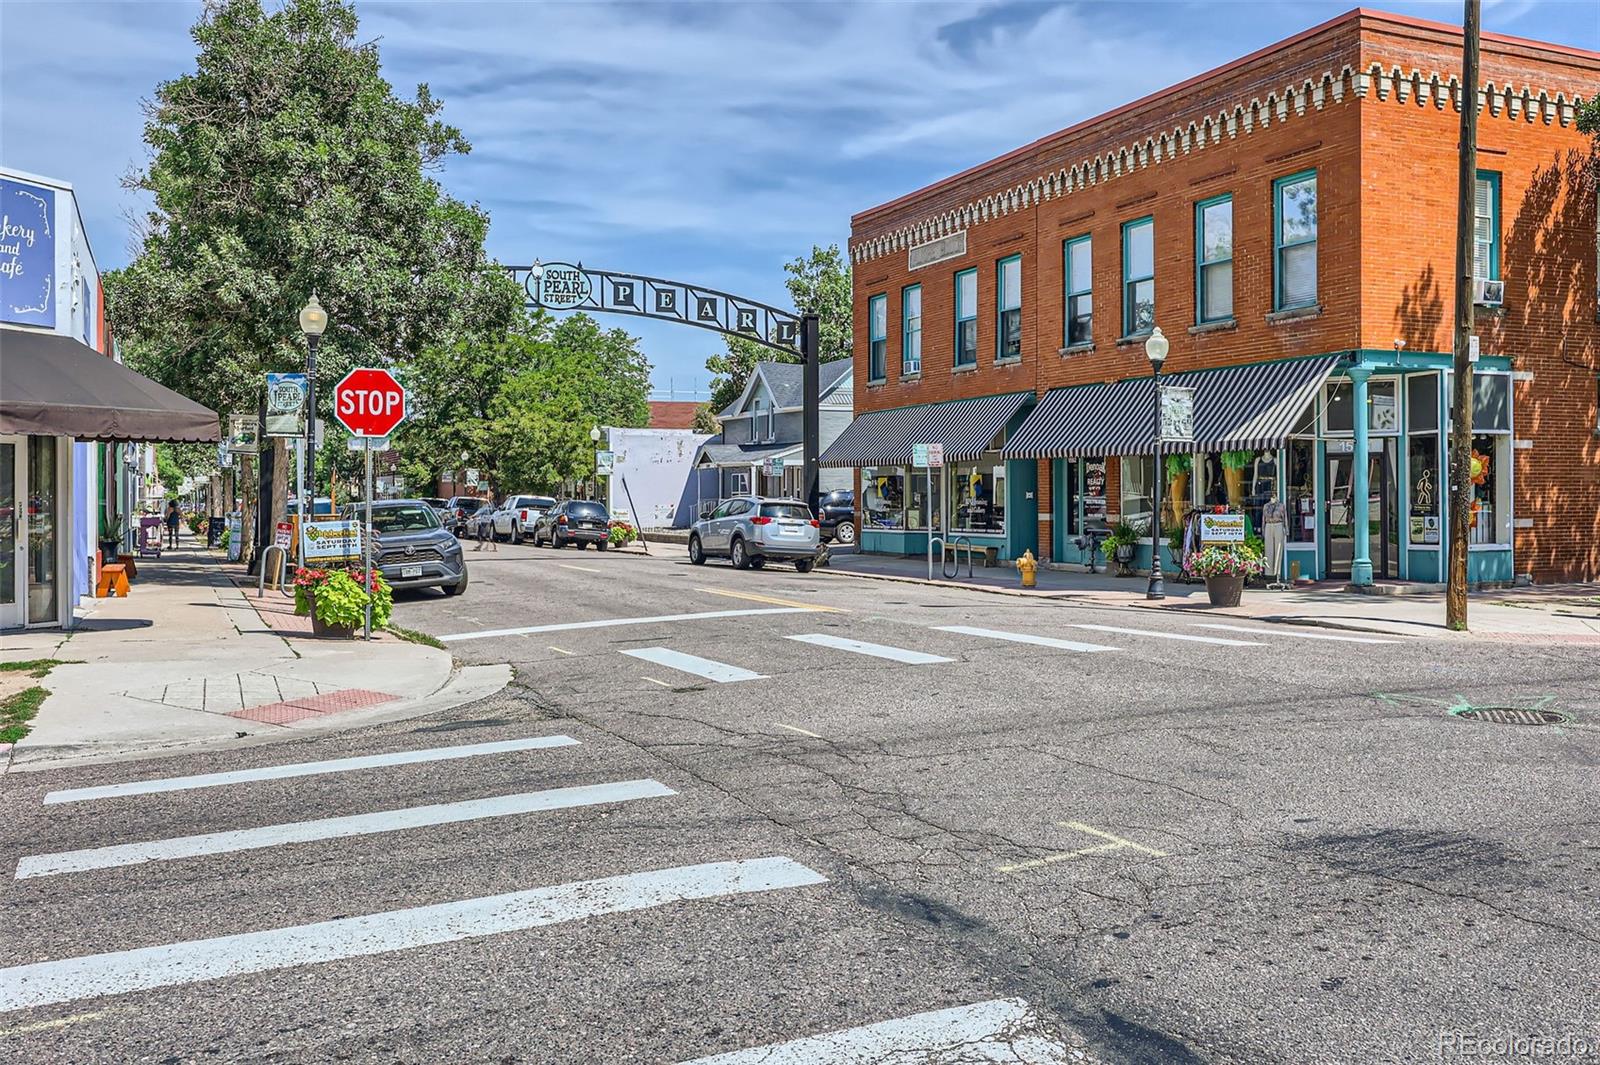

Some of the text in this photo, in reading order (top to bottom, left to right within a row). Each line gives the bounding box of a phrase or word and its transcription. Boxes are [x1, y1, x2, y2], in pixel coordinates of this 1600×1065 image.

[546, 270, 580, 281] SOUTH
[544, 280, 589, 299] PEARL
[544, 294, 577, 304] STREET
[340, 389, 400, 416] STOP
